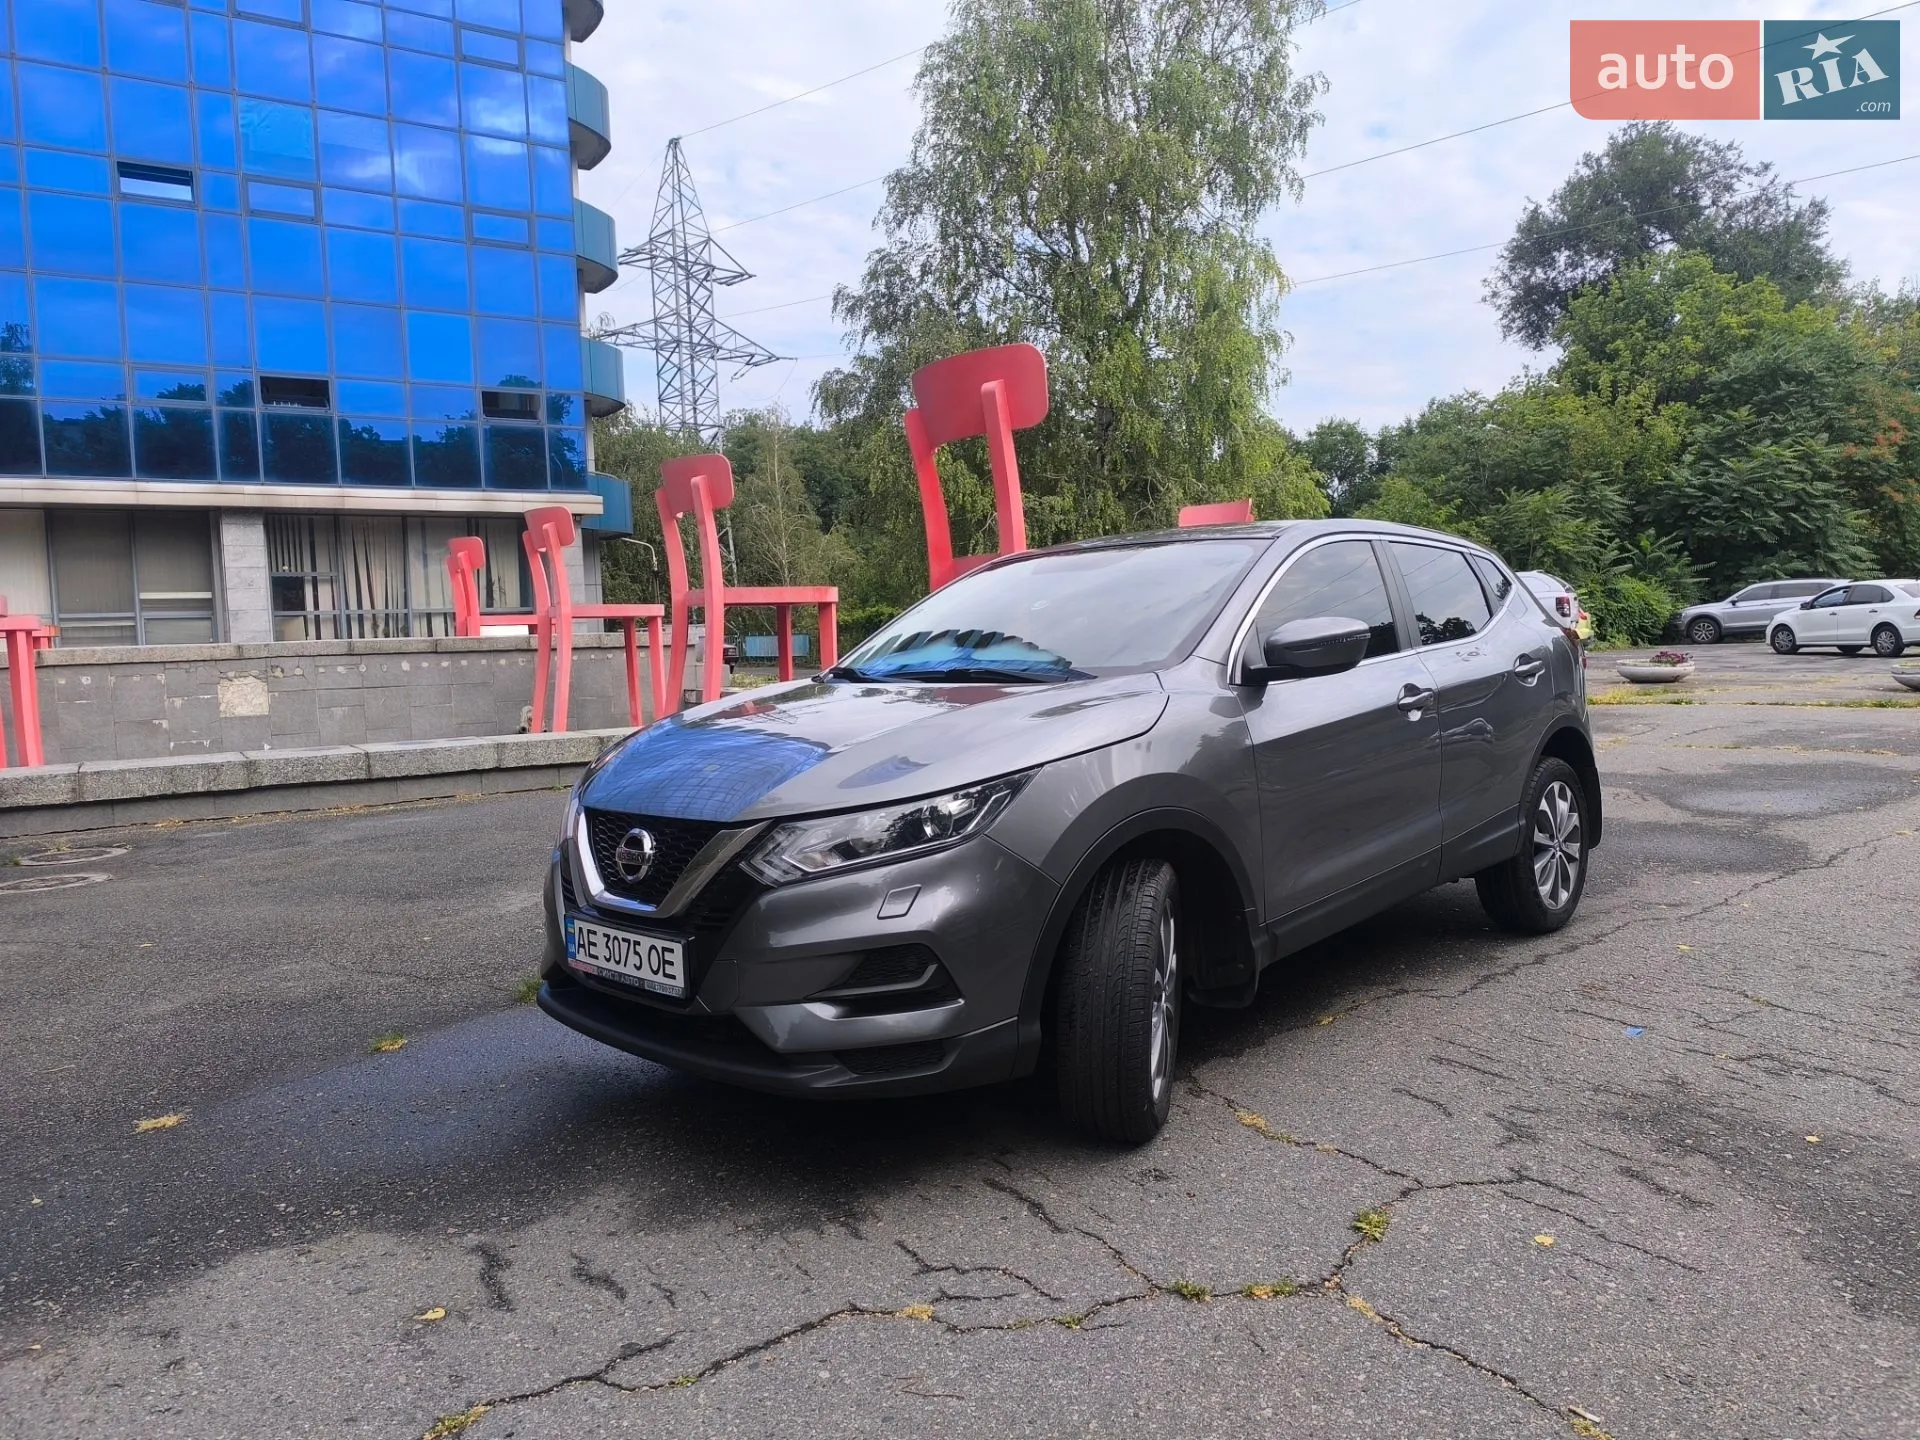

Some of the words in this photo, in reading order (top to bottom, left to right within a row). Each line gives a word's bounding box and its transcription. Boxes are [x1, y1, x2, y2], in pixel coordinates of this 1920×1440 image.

[577, 926, 599, 961] AE
[603, 933, 643, 971] 3075
[648, 944, 677, 980] OE
